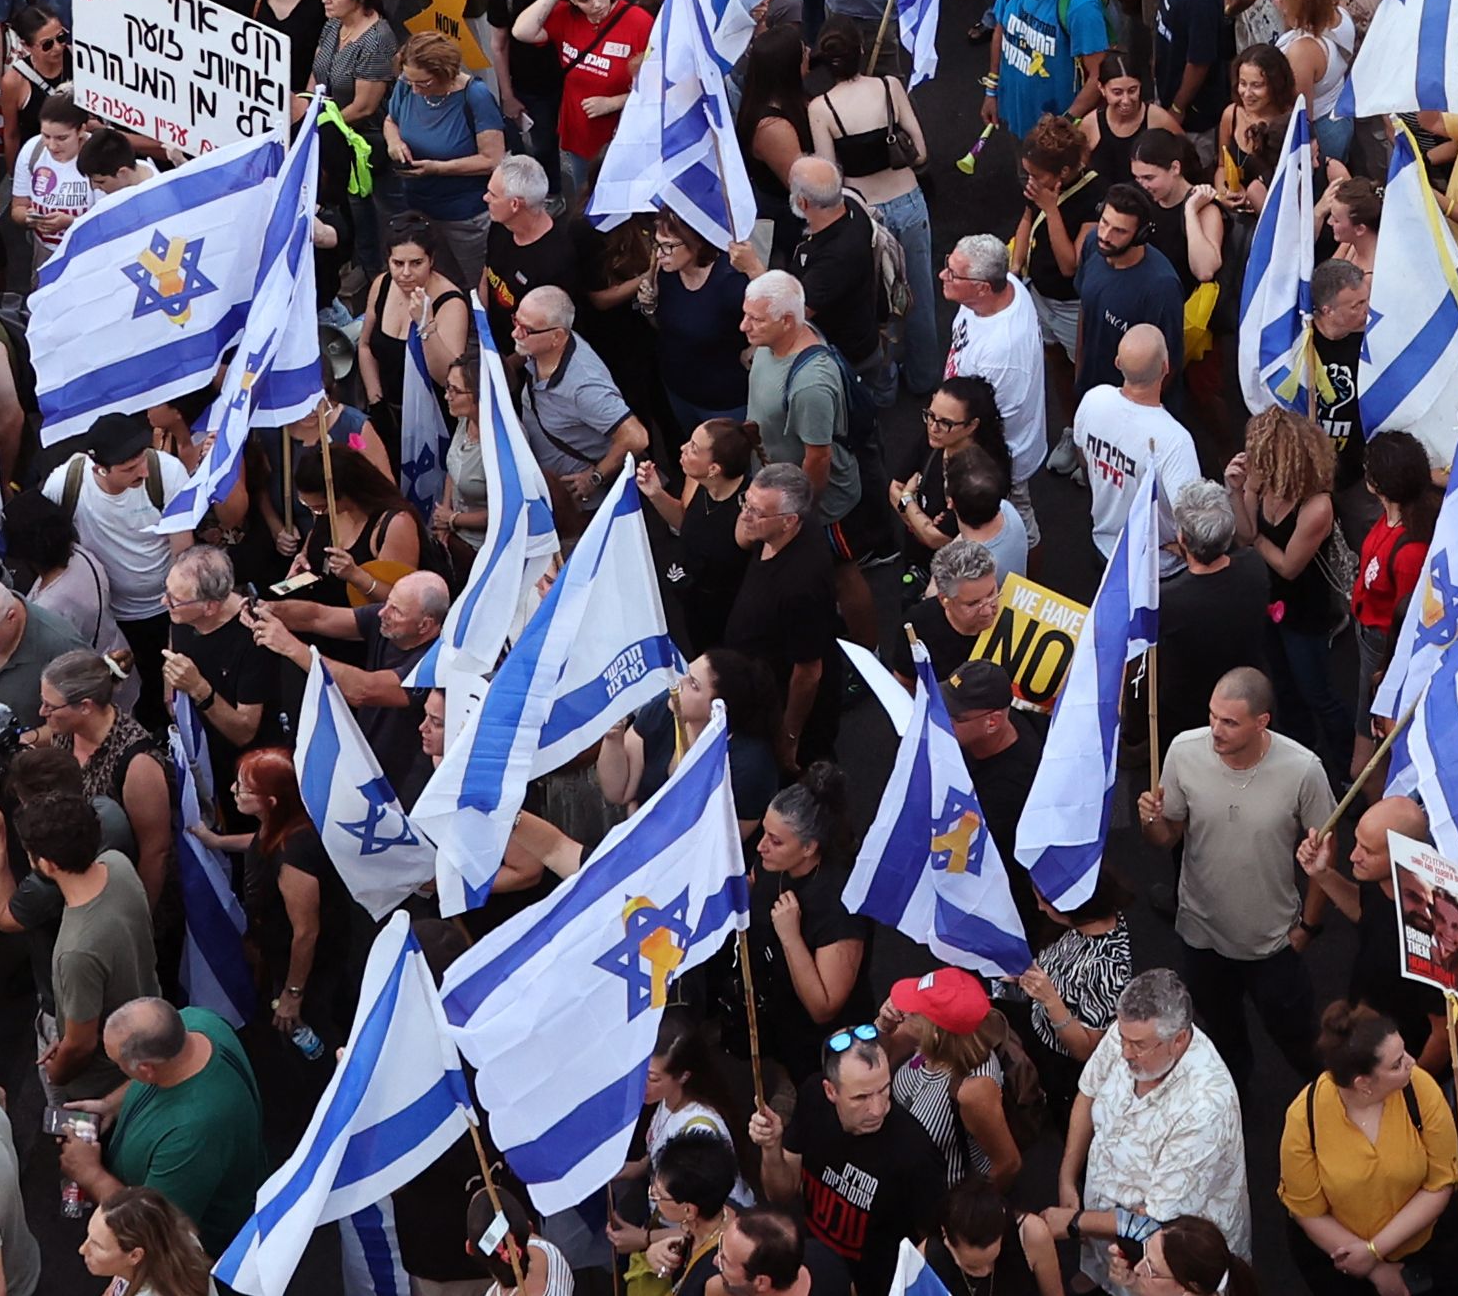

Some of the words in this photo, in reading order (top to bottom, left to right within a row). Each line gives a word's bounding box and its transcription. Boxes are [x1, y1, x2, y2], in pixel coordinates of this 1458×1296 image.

[124, 13, 184, 62] זועק
[231, 20, 282, 75] קול
[435, 11, 461, 41] NOW.
[73, 39, 176, 105] המנהרה
[192, 49, 285, 112] ואחיותי
[189, 82, 218, 127] מן
[1086, 432, 1137, 478] בחירות
[1011, 584, 1041, 613] WE
[1039, 598, 1086, 637] HAVE
[603, 644, 643, 682] חופשי
[983, 607, 1076, 704] NO
[606, 658, 648, 700] בארצנו
[1404, 922, 1431, 948] BRING
[1404, 939, 1431, 961] THEM
